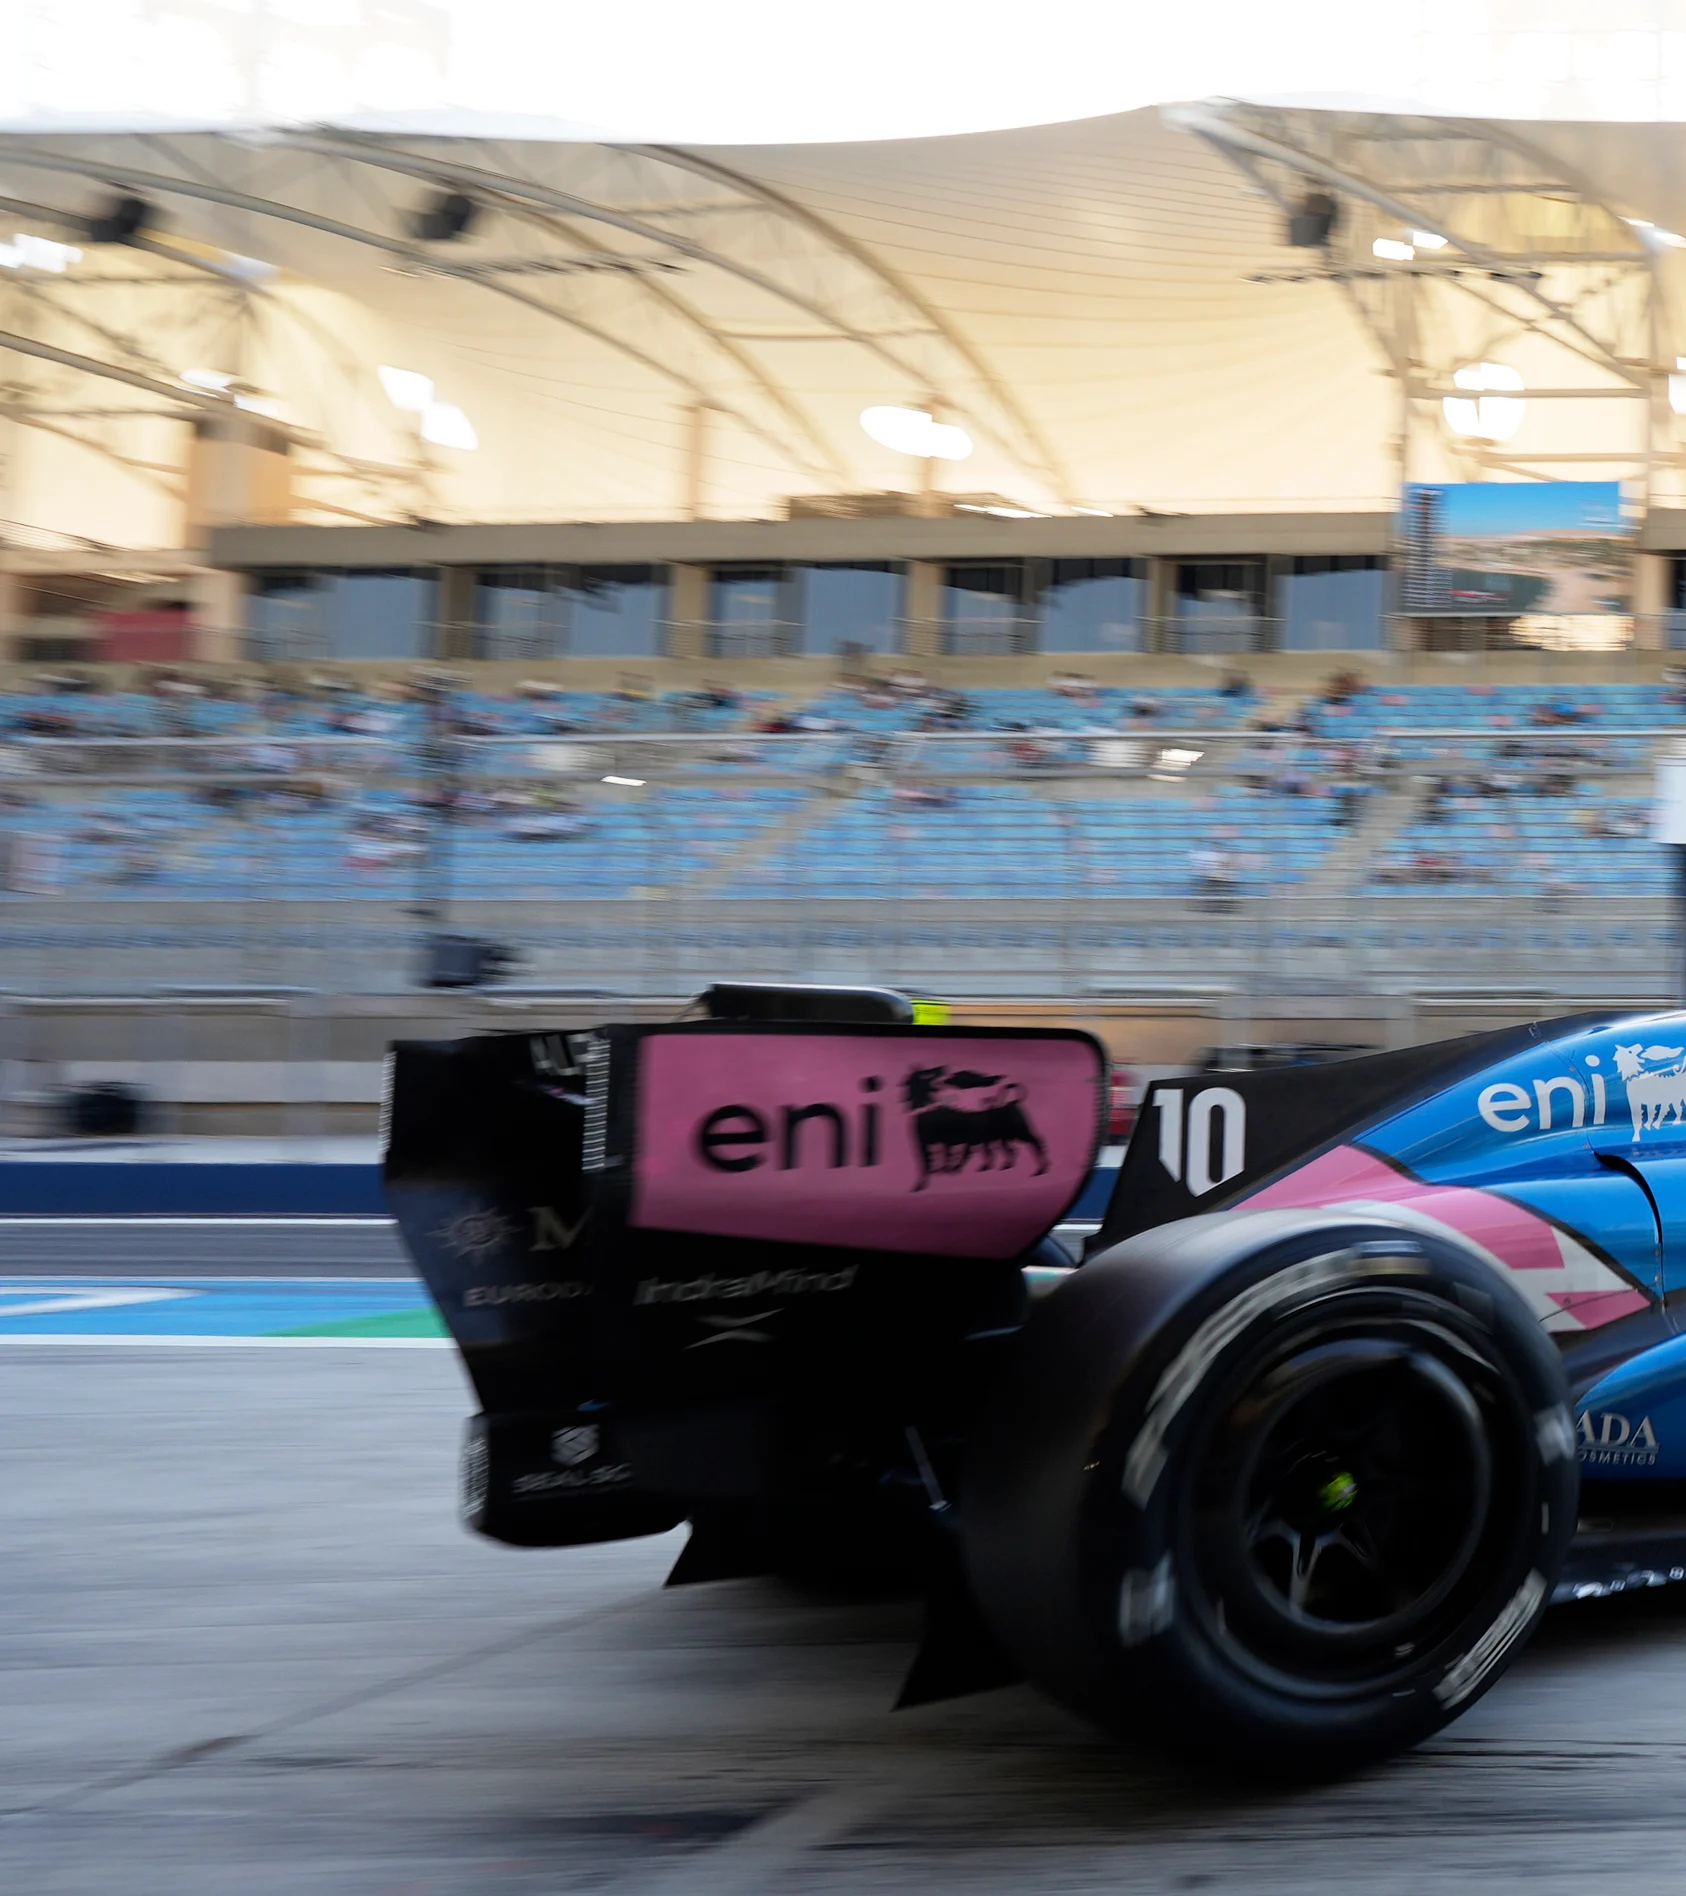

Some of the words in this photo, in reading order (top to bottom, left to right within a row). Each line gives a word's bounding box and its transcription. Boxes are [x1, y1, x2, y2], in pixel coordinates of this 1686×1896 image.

[697, 1075, 884, 1173] eni
[1477, 1055, 1606, 1133] eni
[1152, 1086, 1247, 1198] 10
[1576, 1408, 1660, 1449] ADA
[1579, 1450, 1657, 1466] OSMETICS
